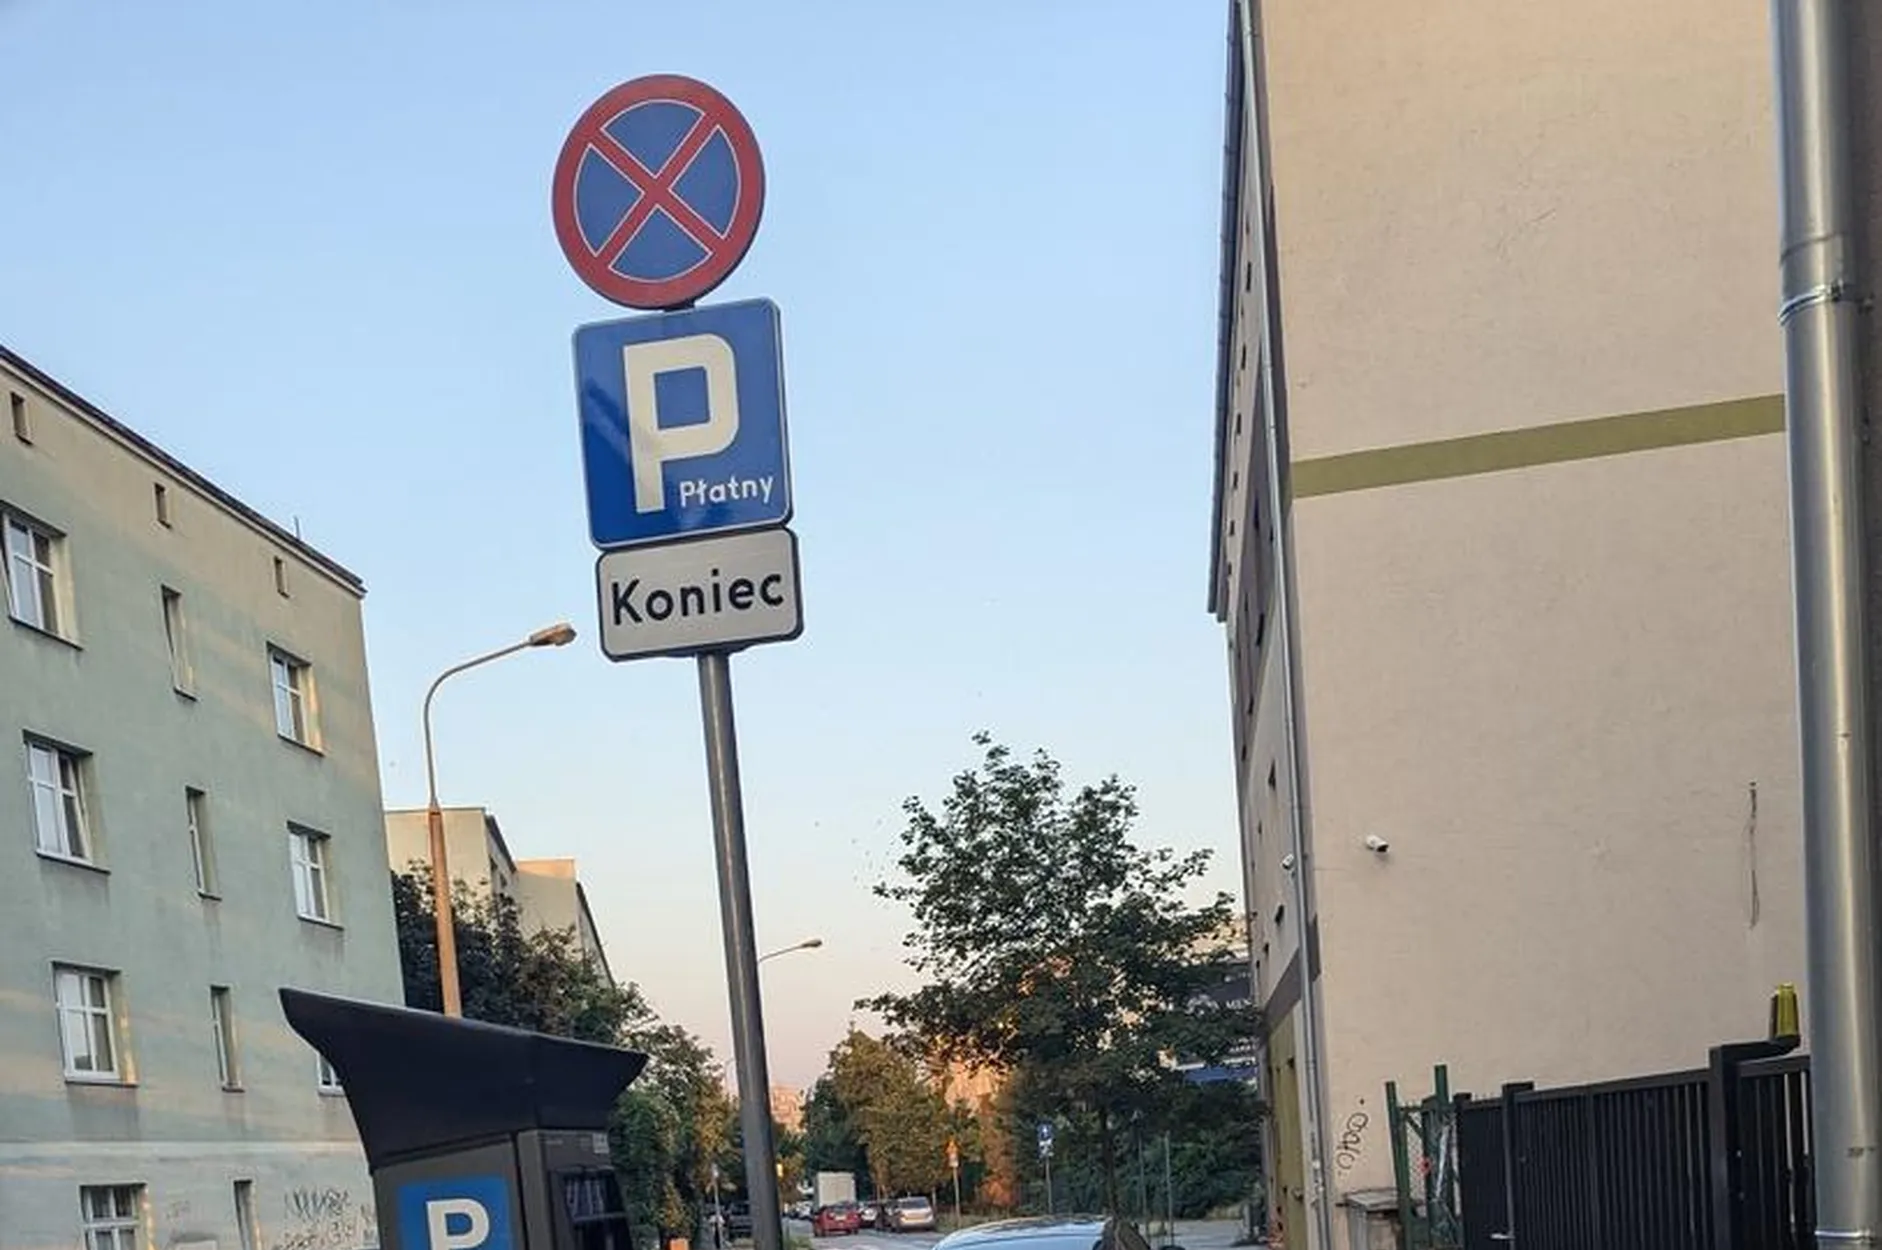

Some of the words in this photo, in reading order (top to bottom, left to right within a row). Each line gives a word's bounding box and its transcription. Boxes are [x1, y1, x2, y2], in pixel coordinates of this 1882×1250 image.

[623, 333, 740, 514] P
[680, 475, 773, 508] Płatny
[612, 568, 784, 626] Koniec
